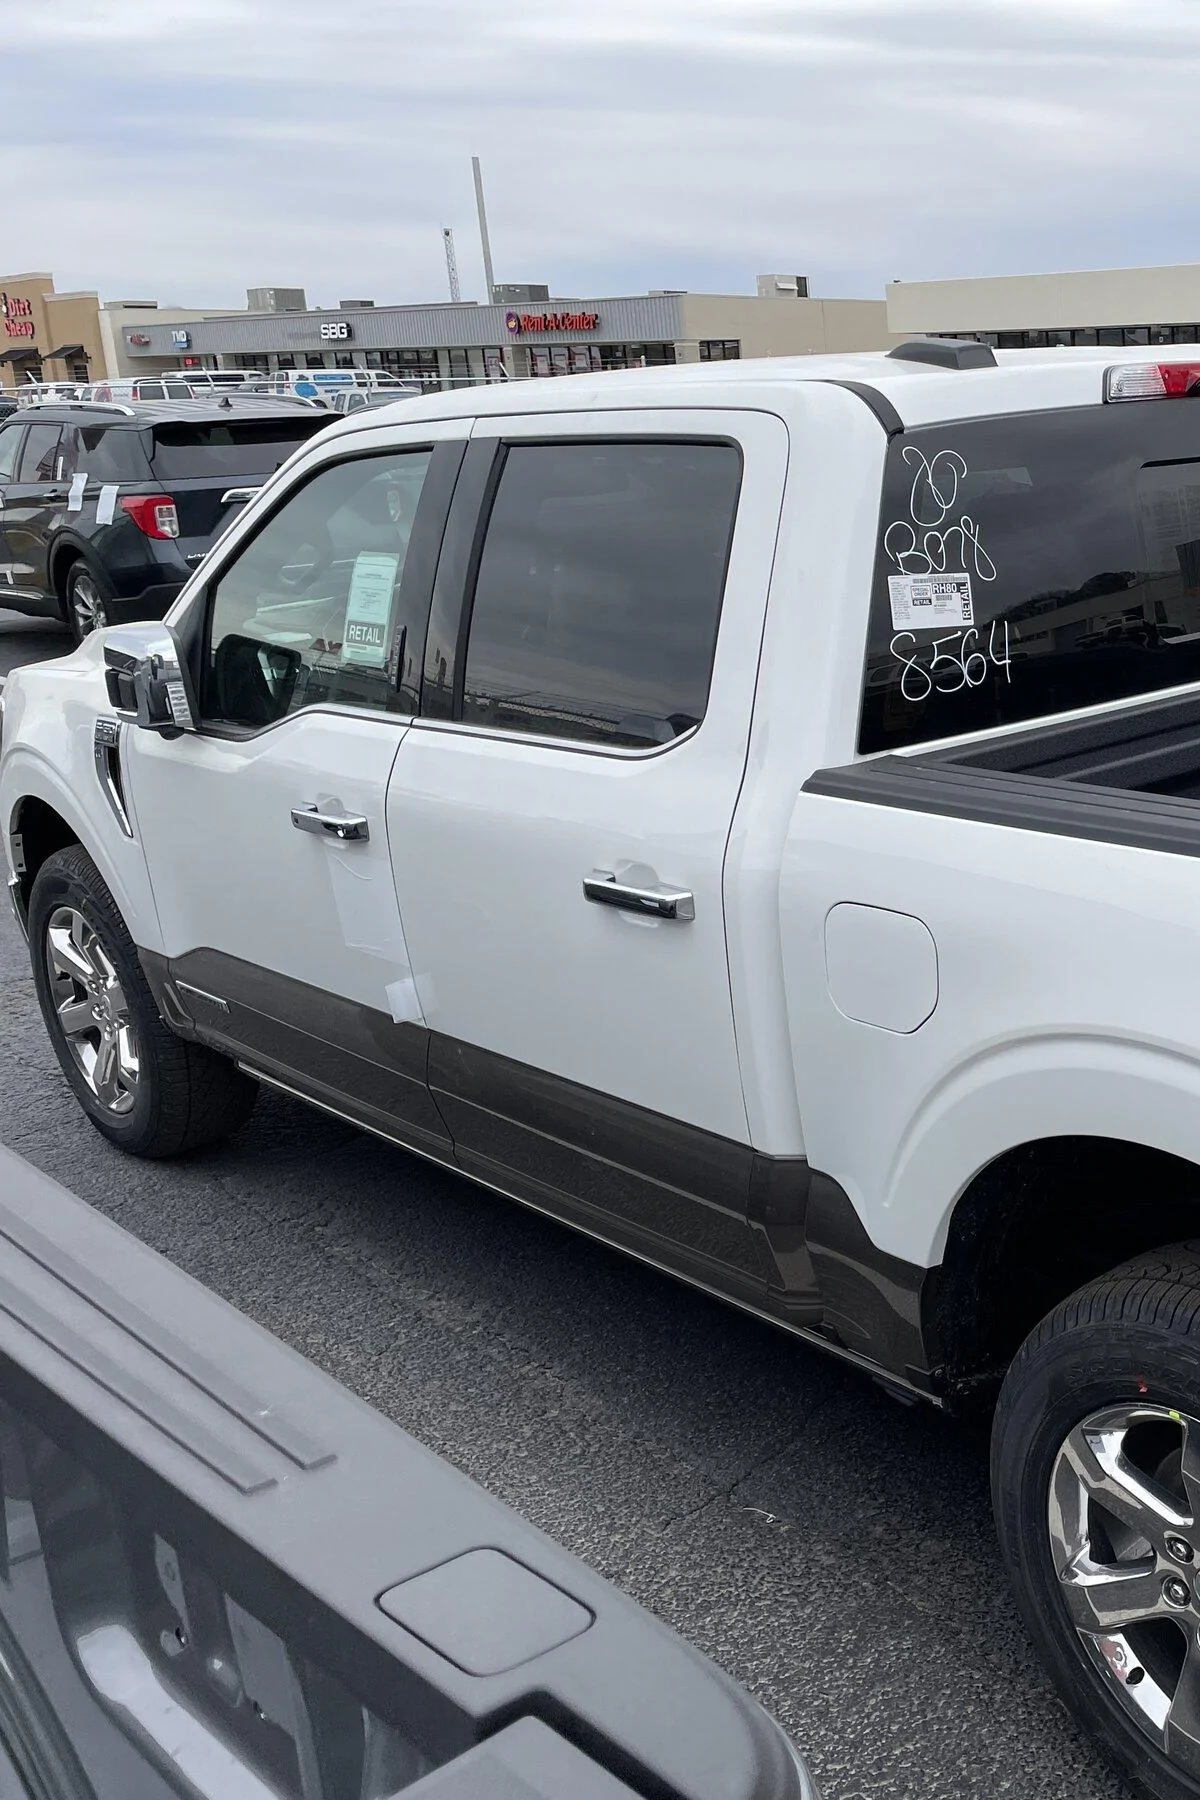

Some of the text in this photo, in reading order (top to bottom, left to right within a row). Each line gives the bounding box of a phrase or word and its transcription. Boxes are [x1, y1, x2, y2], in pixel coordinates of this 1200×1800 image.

[7, 297, 32, 317] Dirt
[5, 317, 35, 339] Cheap
[320, 322, 349, 340] SBG
[932, 583, 957, 595] RH80
[959, 583, 971, 620] RETAIL
[348, 624, 381, 643] RETAIL
[889, 619, 1012, 702] 8564
